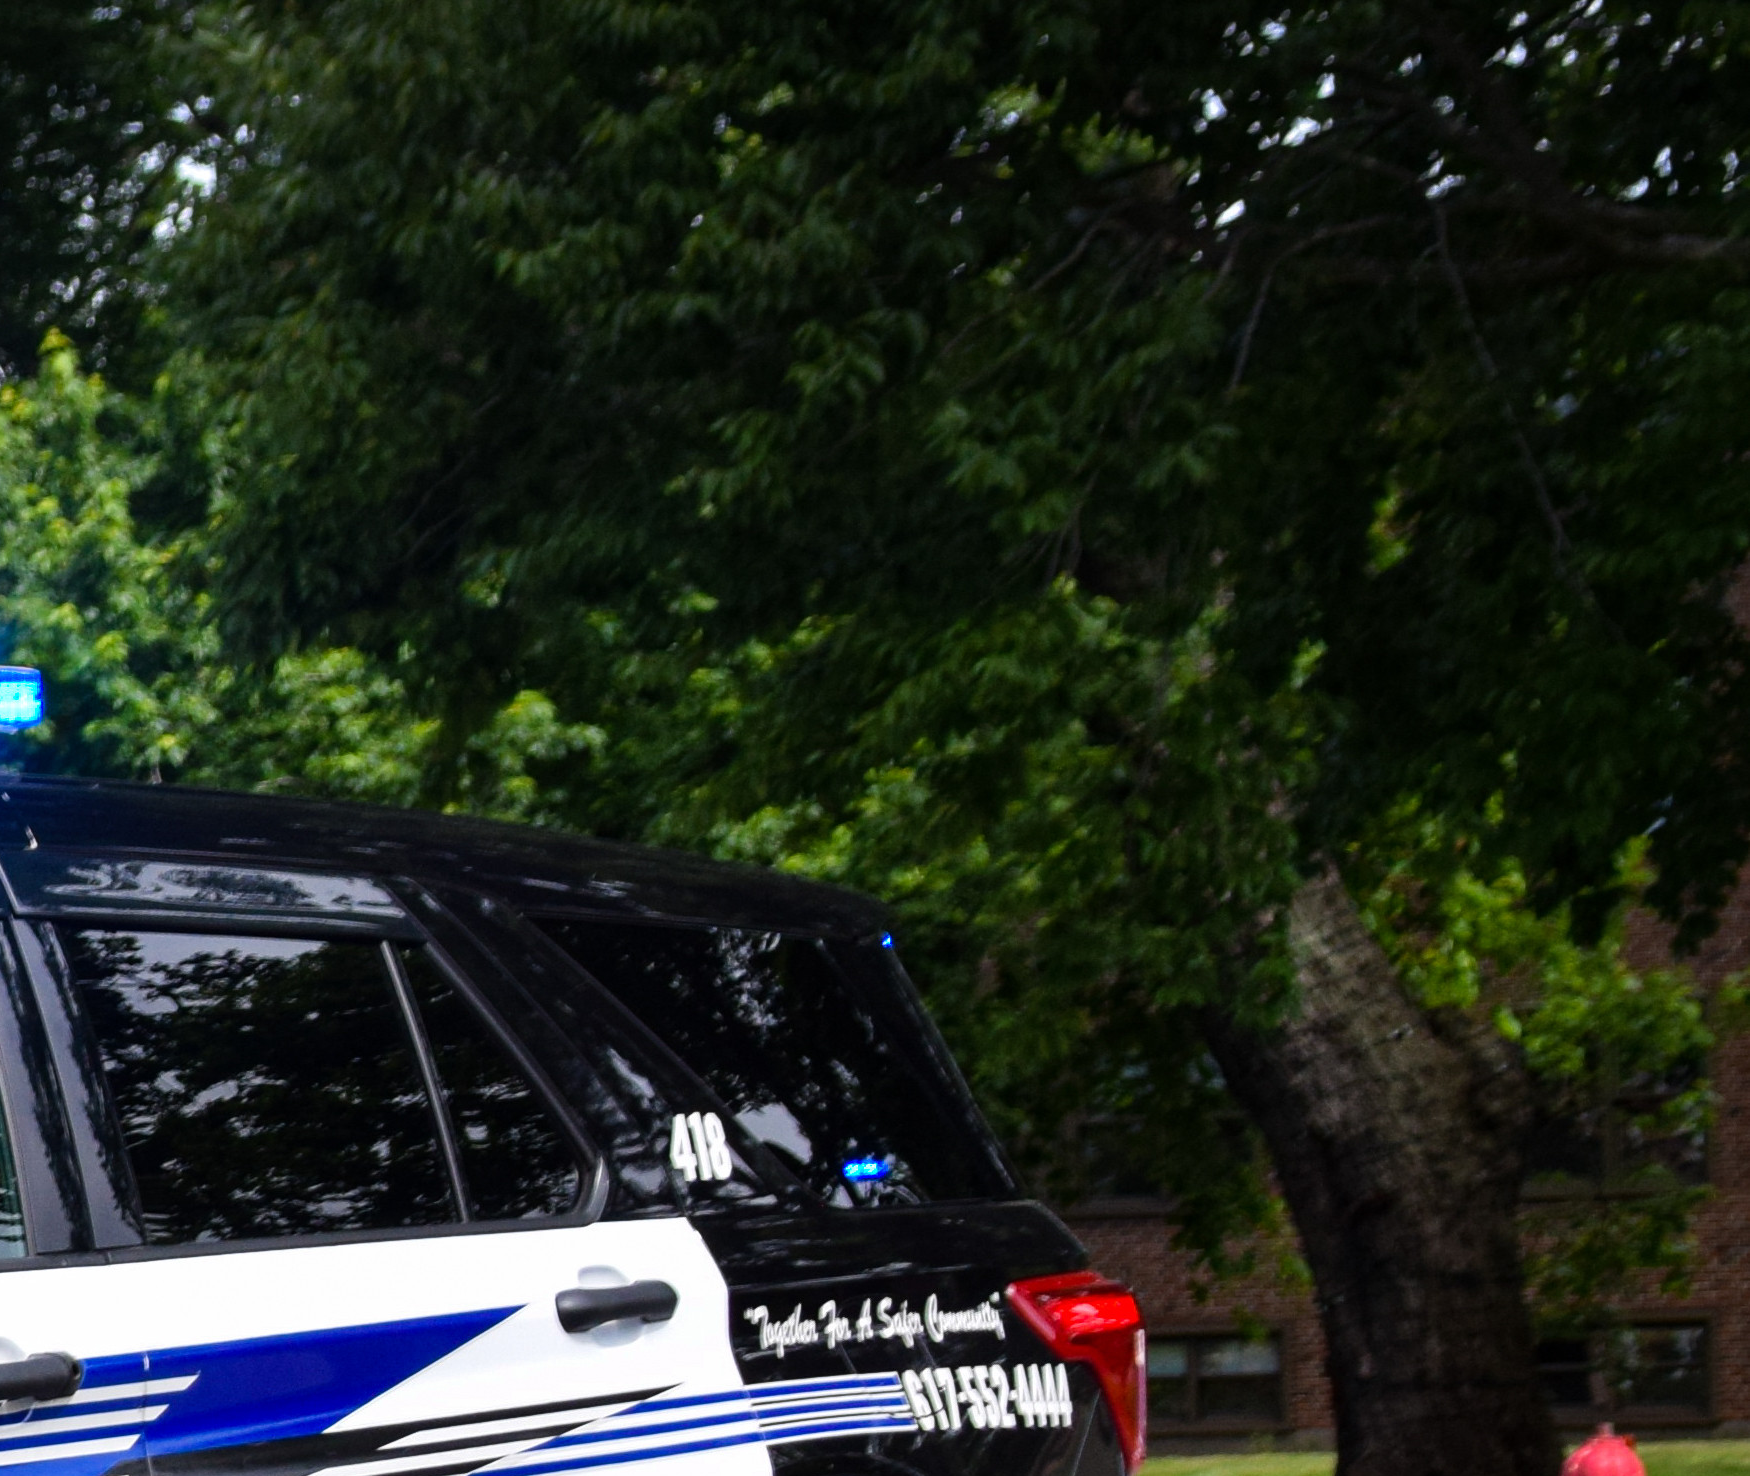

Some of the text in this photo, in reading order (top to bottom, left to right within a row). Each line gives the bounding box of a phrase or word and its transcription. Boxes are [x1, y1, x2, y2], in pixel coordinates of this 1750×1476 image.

[669, 1111, 733, 1182] 418
[818, 1299, 852, 1349] For
[856, 1297, 874, 1342] A
[876, 1296, 925, 1348] Safer
[901, 1363, 1073, 1431] 617-552-4444
